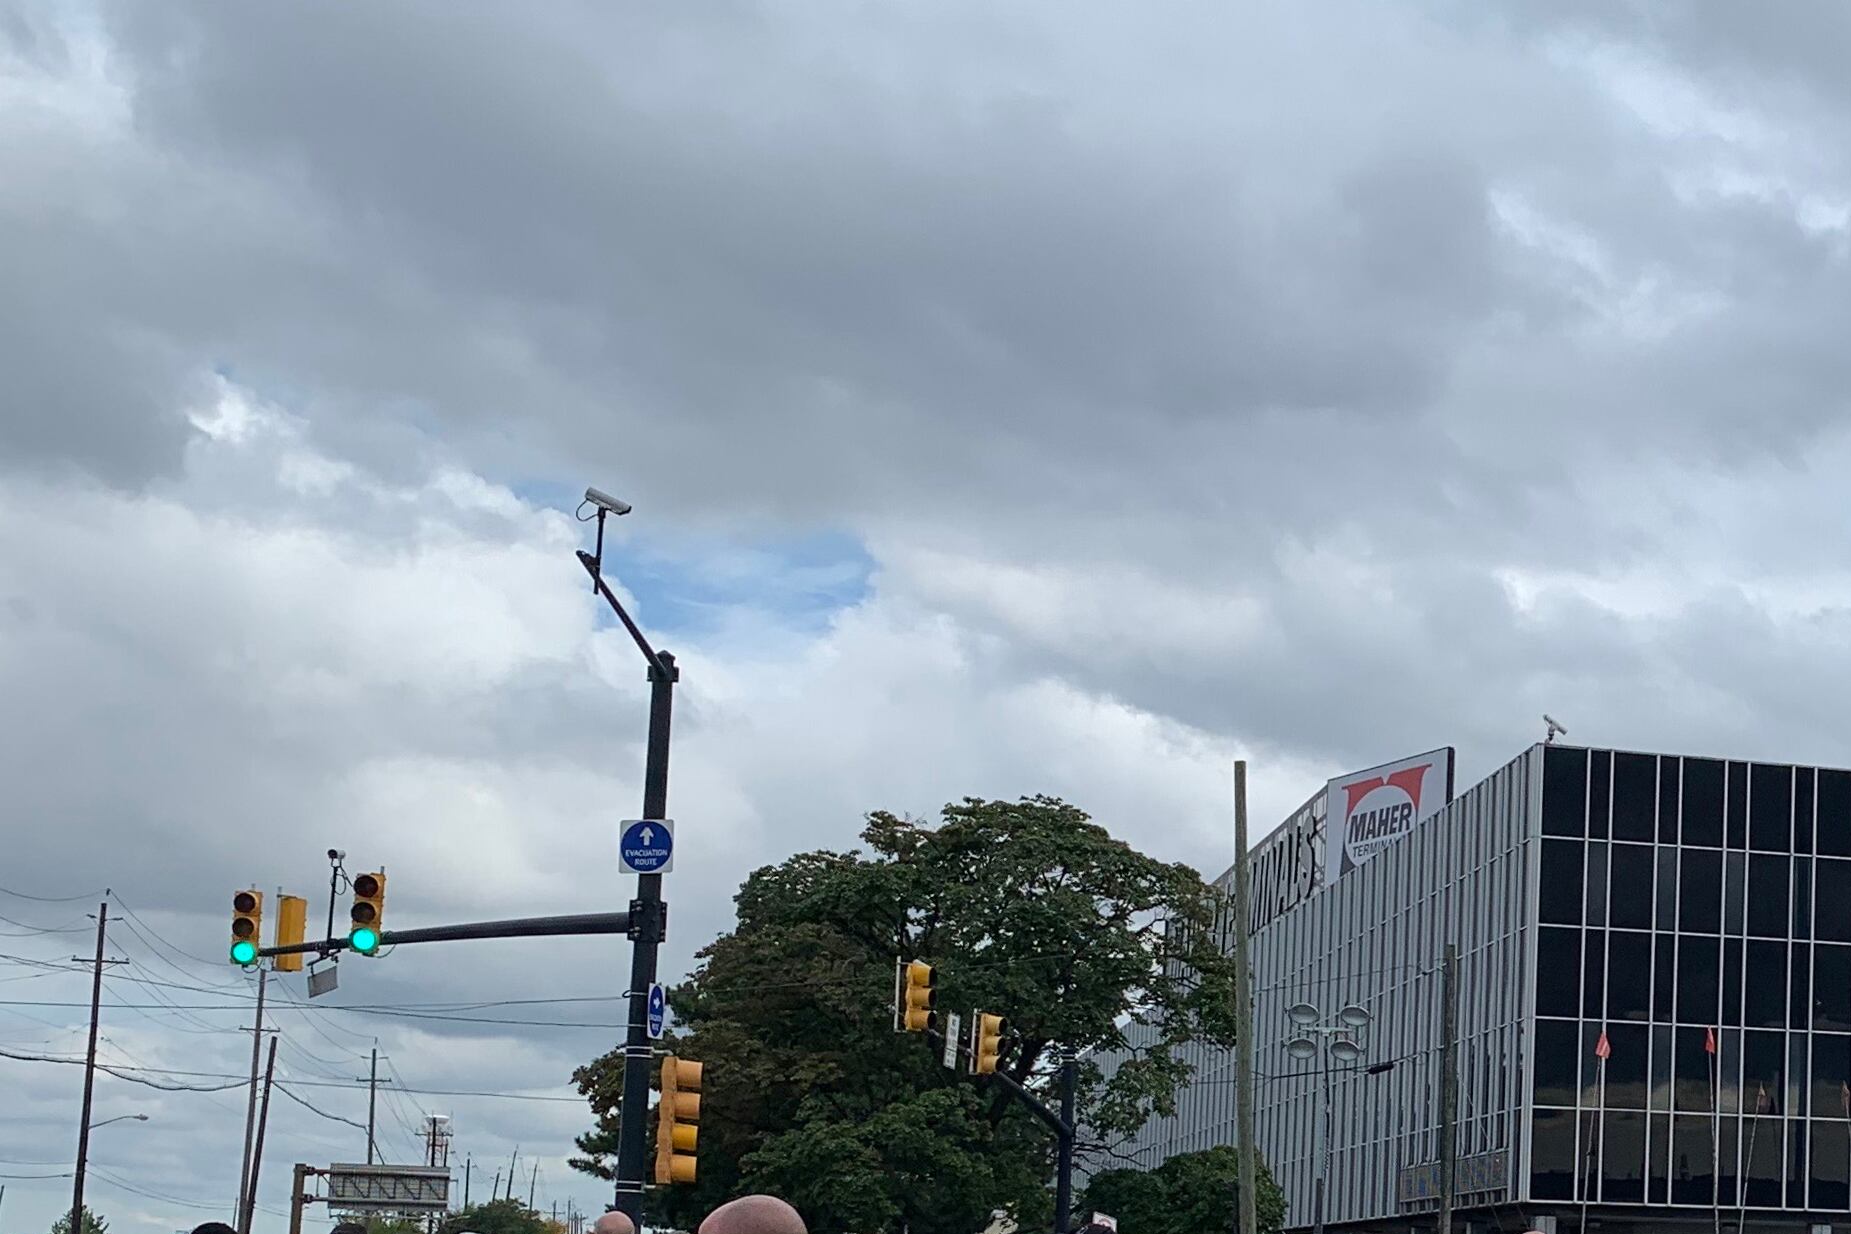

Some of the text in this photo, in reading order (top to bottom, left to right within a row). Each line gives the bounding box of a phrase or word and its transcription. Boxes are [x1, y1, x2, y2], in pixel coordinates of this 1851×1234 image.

[1348, 802, 1412, 844] MAHER
[625, 849, 667, 857] EVACUATION
[634, 858, 657, 866] ROUTE
